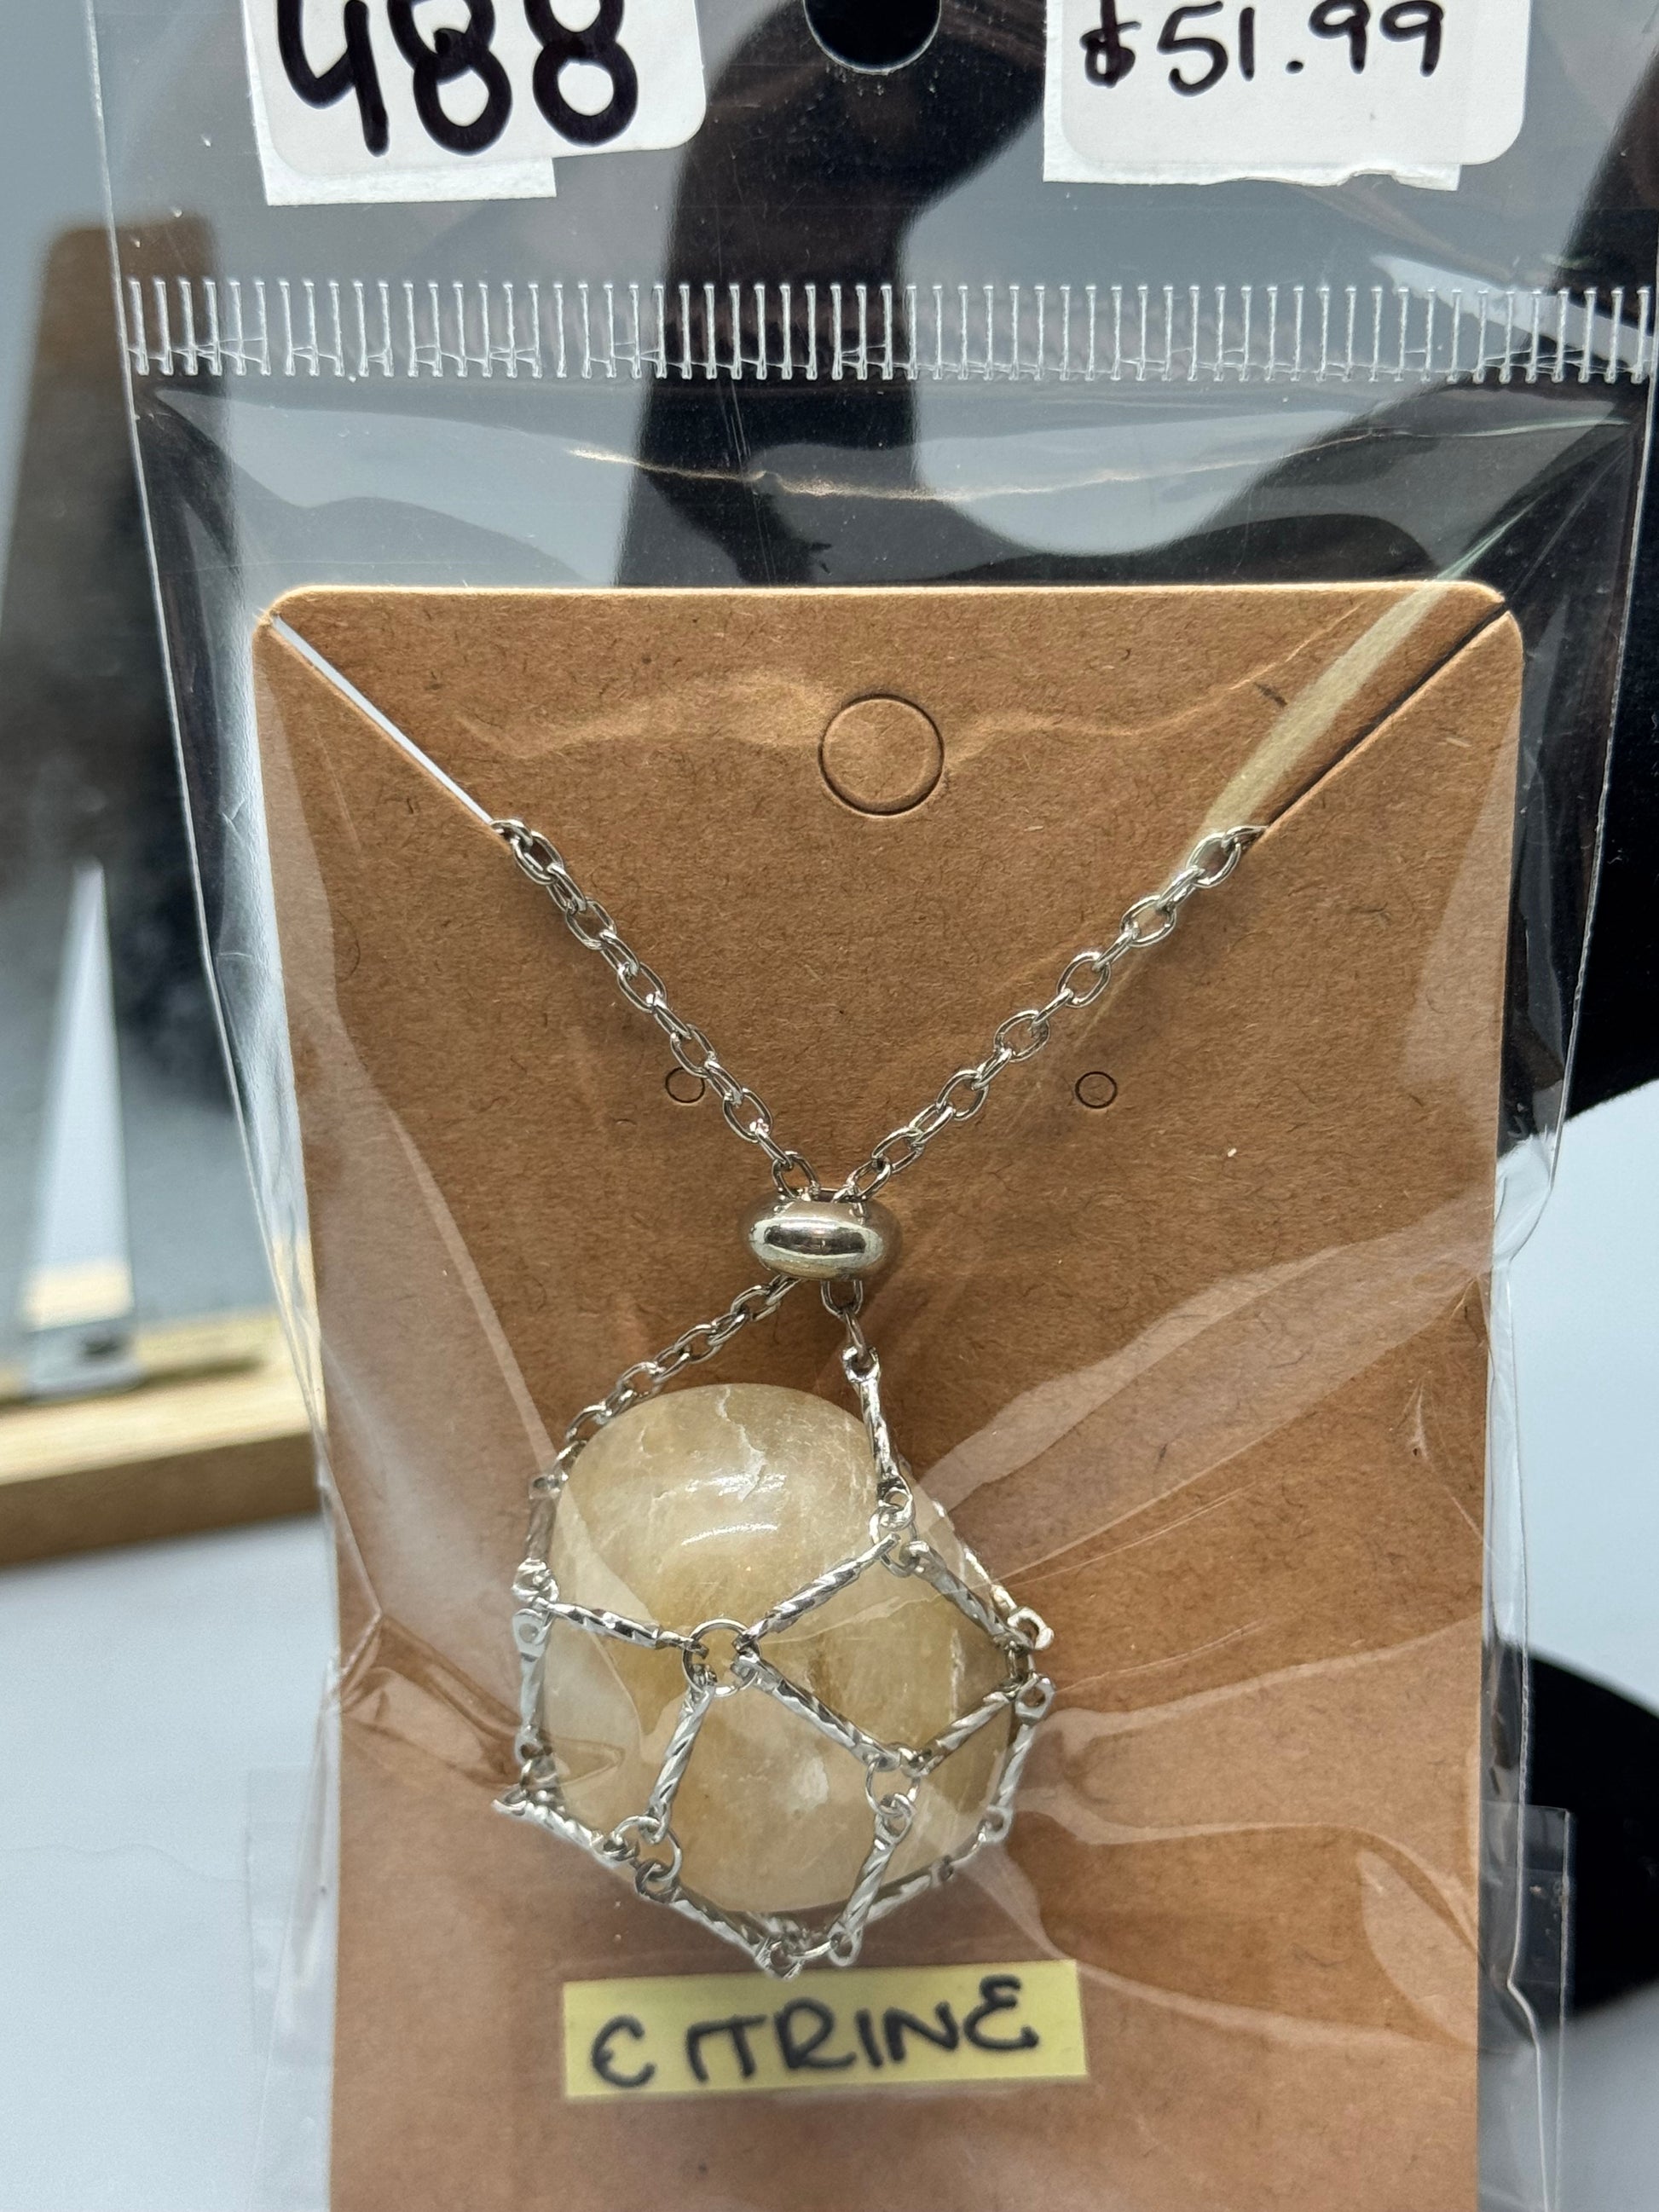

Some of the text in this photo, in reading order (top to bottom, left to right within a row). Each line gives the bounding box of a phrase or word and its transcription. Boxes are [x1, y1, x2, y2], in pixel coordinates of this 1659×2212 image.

[277, 0, 639, 157] 488
[1079, 0, 1444, 96] $51.99
[592, 1973, 1039, 2088] CITRINE
